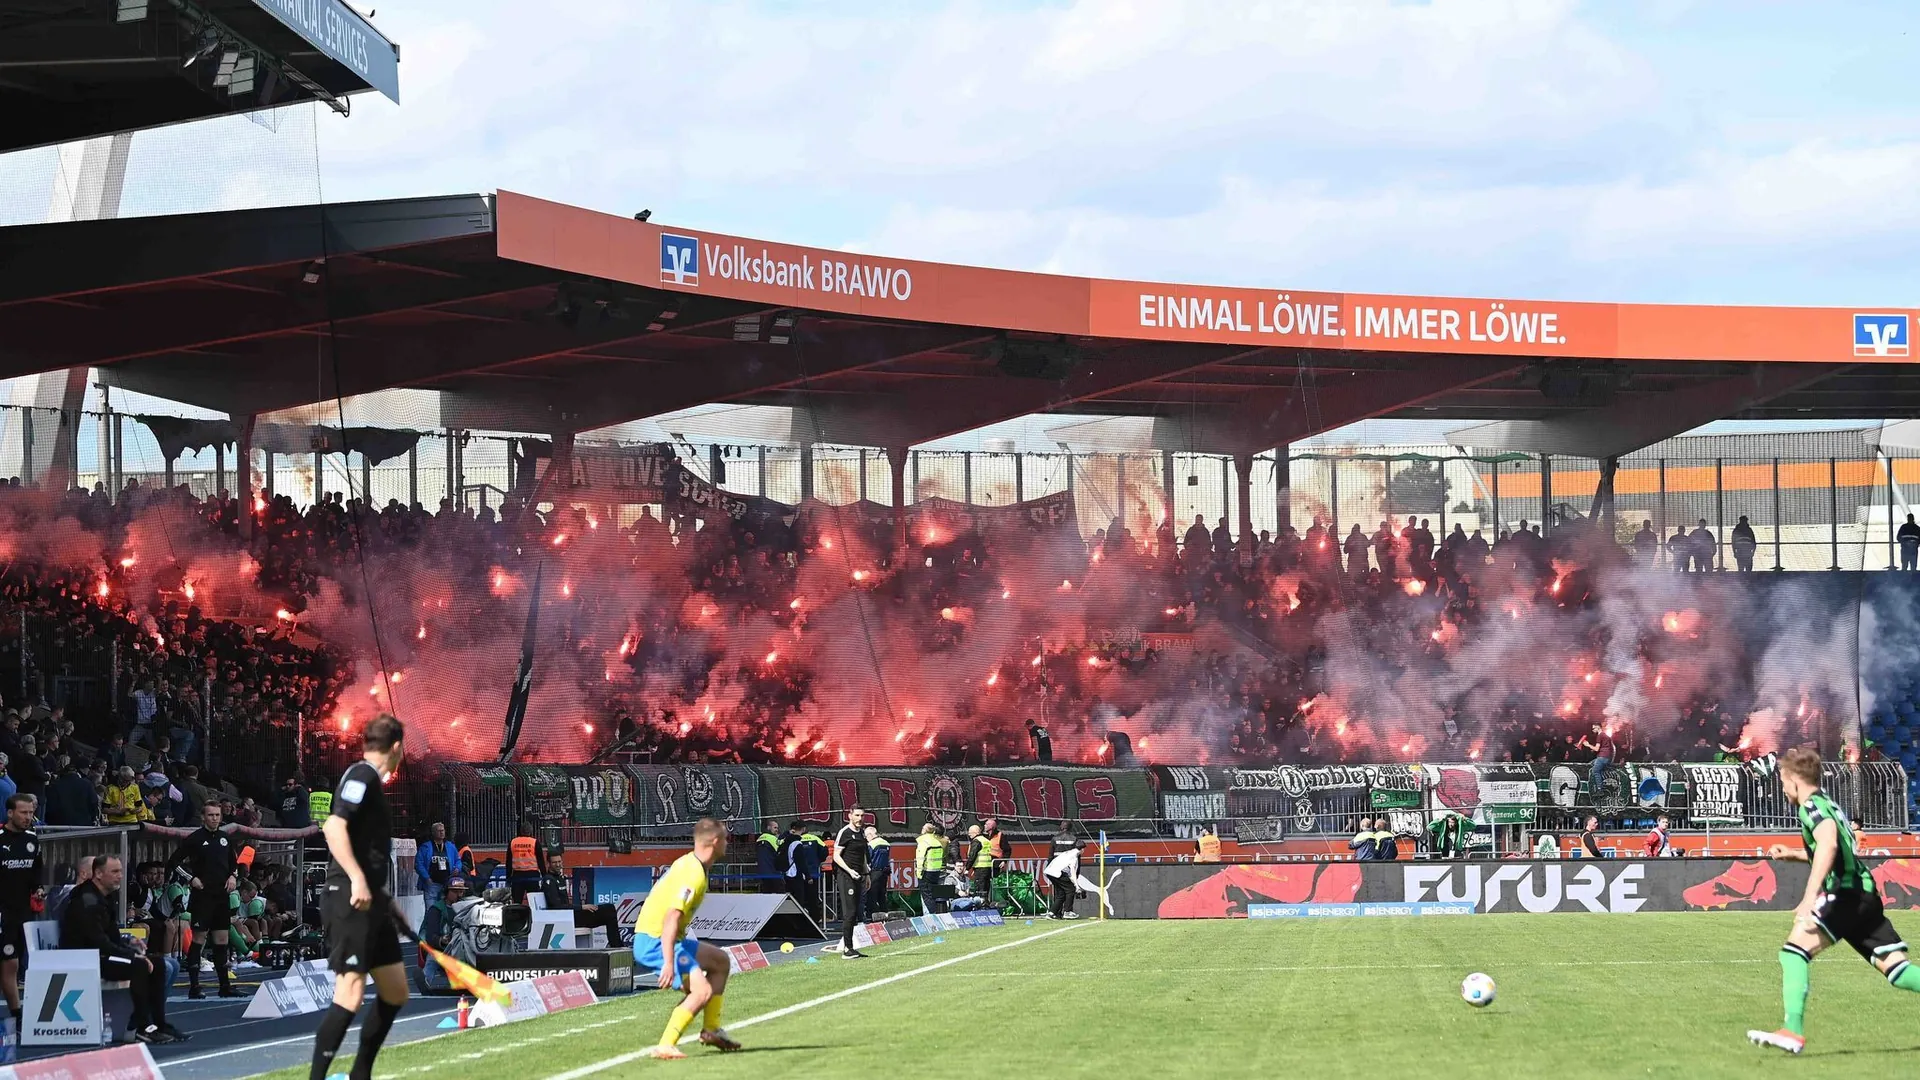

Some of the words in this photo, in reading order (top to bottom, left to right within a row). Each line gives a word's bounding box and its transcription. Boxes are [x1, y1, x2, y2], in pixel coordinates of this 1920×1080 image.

[325, 6, 369, 75] SERVICES
[703, 243, 815, 290] Volksbank
[821, 260, 912, 301] BRAWO
[1139, 294, 1252, 333] EINMAL
[1257, 294, 1347, 337] LÖWE.
[1355, 306, 1461, 341] IMMER
[1469, 303, 1567, 344] LÖWE.
[1167, 766, 1209, 790] WEST
[1385, 775, 1416, 790] BURG
[1691, 767, 1740, 784] GEGEN
[1696, 784, 1739, 802] STADT
[1519, 808, 1534, 819] 96
[1692, 801, 1744, 817] VERBOTE
[2, 859, 34, 867] KOSATE
[1404, 863, 1648, 914] FUTURE
[487, 969, 598, 981] BUNDESLIGAOM
[33, 1026, 88, 1037] Kroschke
